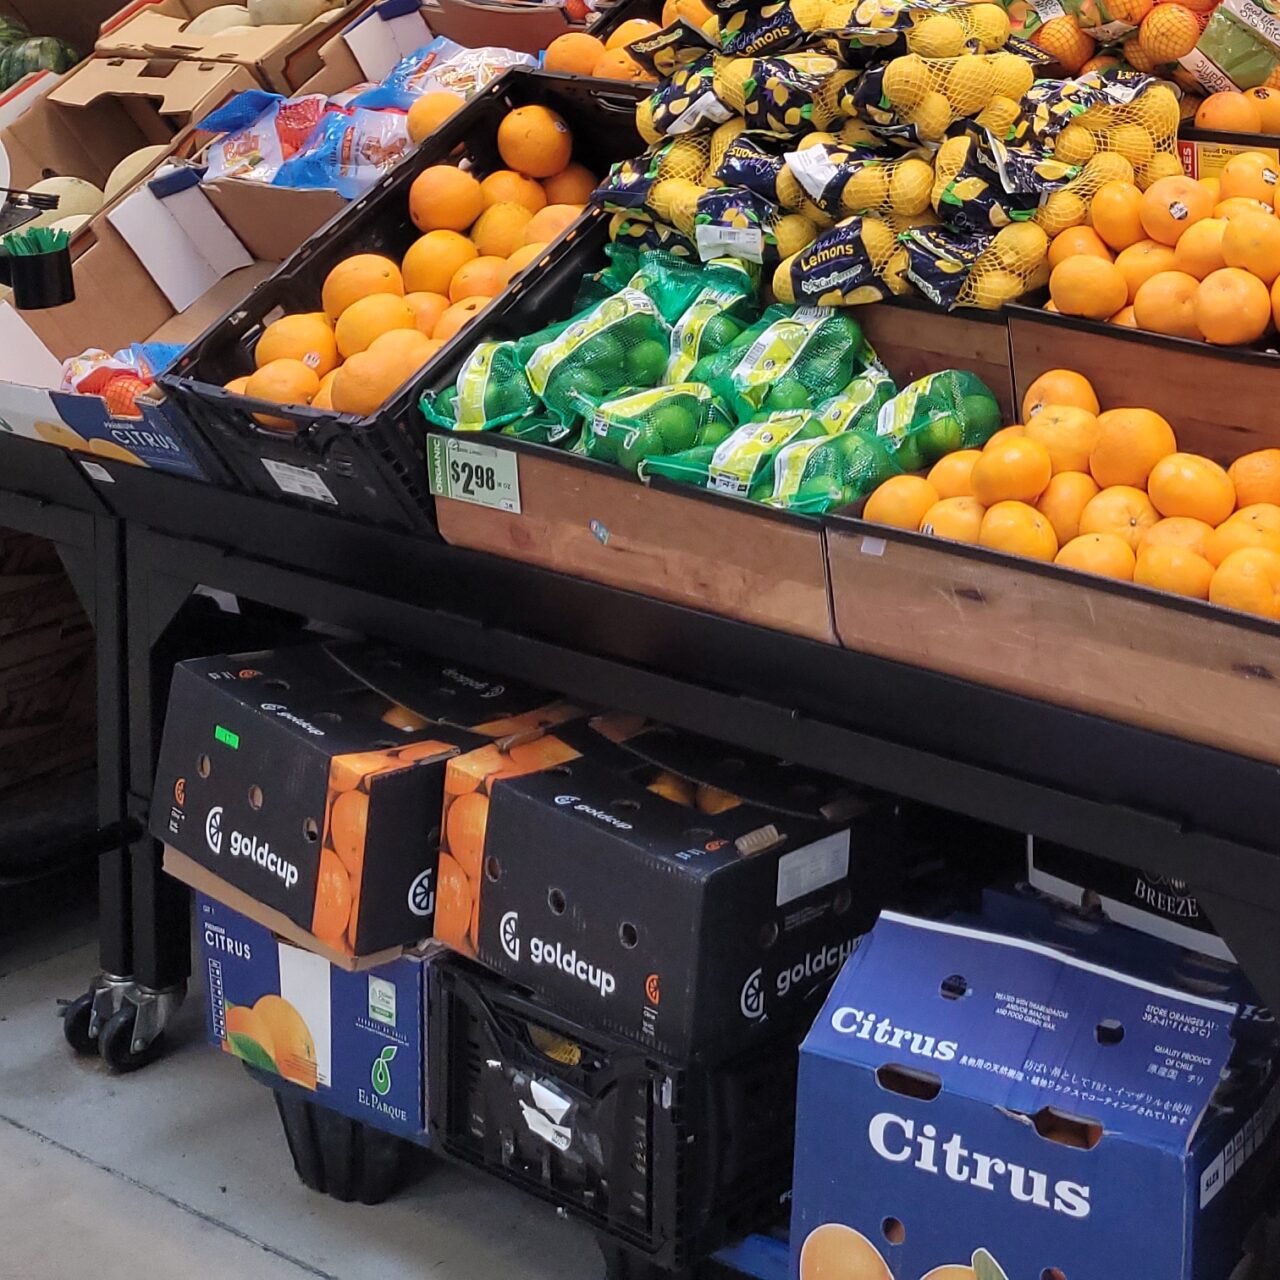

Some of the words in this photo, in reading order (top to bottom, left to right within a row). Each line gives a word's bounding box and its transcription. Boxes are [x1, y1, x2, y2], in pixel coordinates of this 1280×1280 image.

[801, 244, 854, 271] Lemons
[111, 430, 180, 452] CITRUS
[433, 439, 443, 493] ORGANIC
[574, 803, 633, 830] goldcup
[230, 830, 298, 888] goldcup
[1135, 877, 1199, 918] BREEZE
[205, 930, 251, 960] CITRUS
[530, 936, 616, 997] goldcup
[1146, 1005, 1167, 1019] STORE
[1169, 1011, 1203, 1027] ORANGES
[831, 1007, 959, 1061] Citrus
[1154, 1044, 1180, 1058] QUALITY
[1180, 1051, 1212, 1066] PRODUCE
[1165, 1058, 1175, 1067] OF
[1175, 1060, 1194, 1072] CHILE
[868, 1112, 1091, 1218] Citrus
[1205, 1170, 1219, 1192] SIZE
